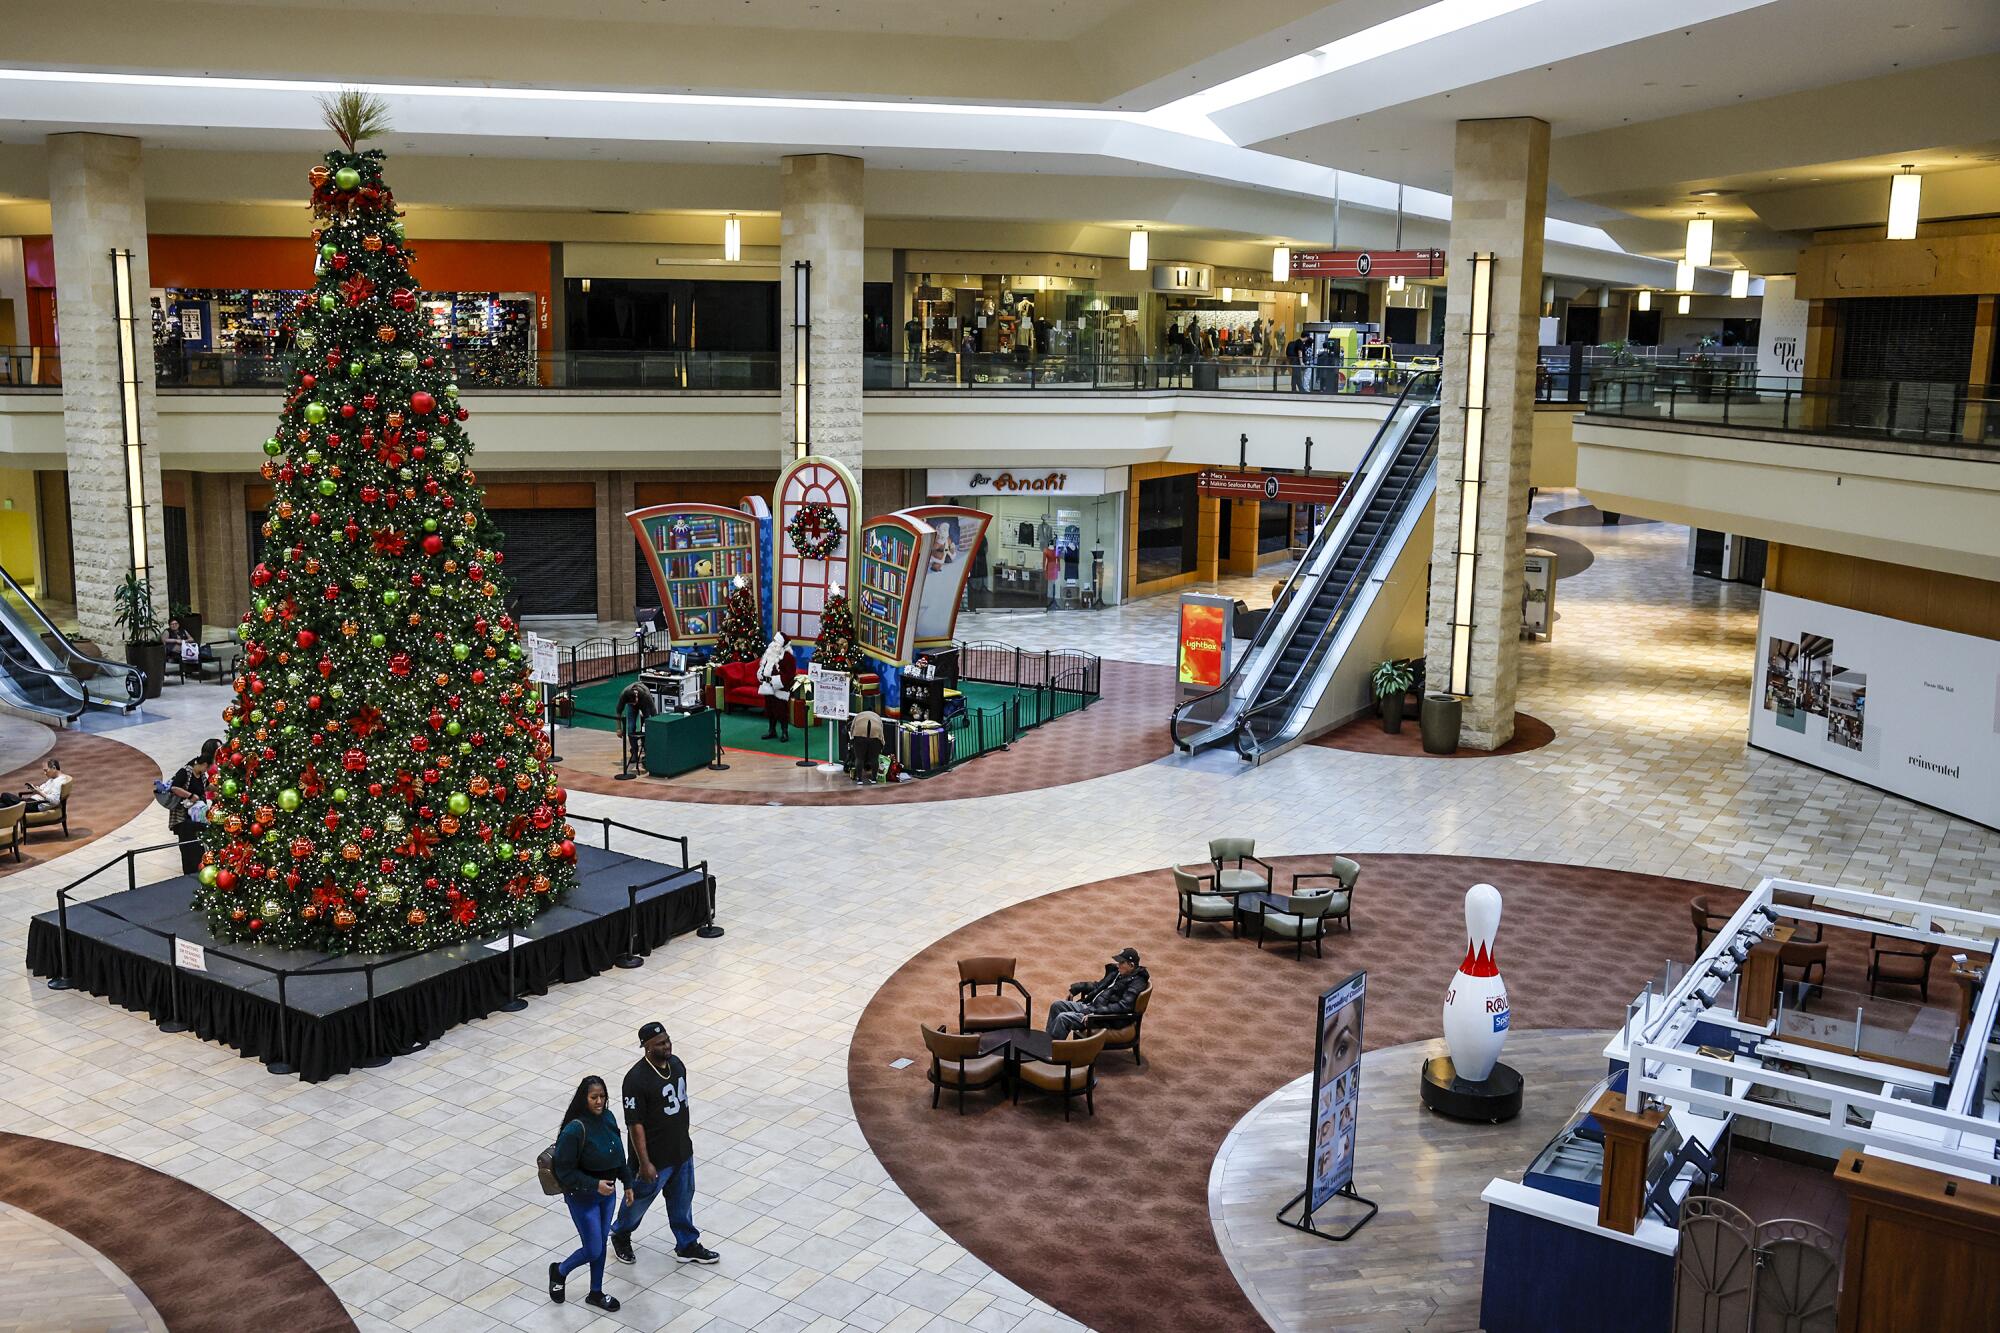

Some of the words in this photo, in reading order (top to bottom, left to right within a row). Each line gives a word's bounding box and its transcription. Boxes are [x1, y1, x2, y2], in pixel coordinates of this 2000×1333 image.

[1773, 338, 1796, 365] epi
[970, 472, 992, 488] for
[992, 472, 1067, 492] Anahi
[1908, 754, 1960, 779] reinvented
[624, 1096, 636, 1110] 34
[662, 1076, 689, 1116] 34
